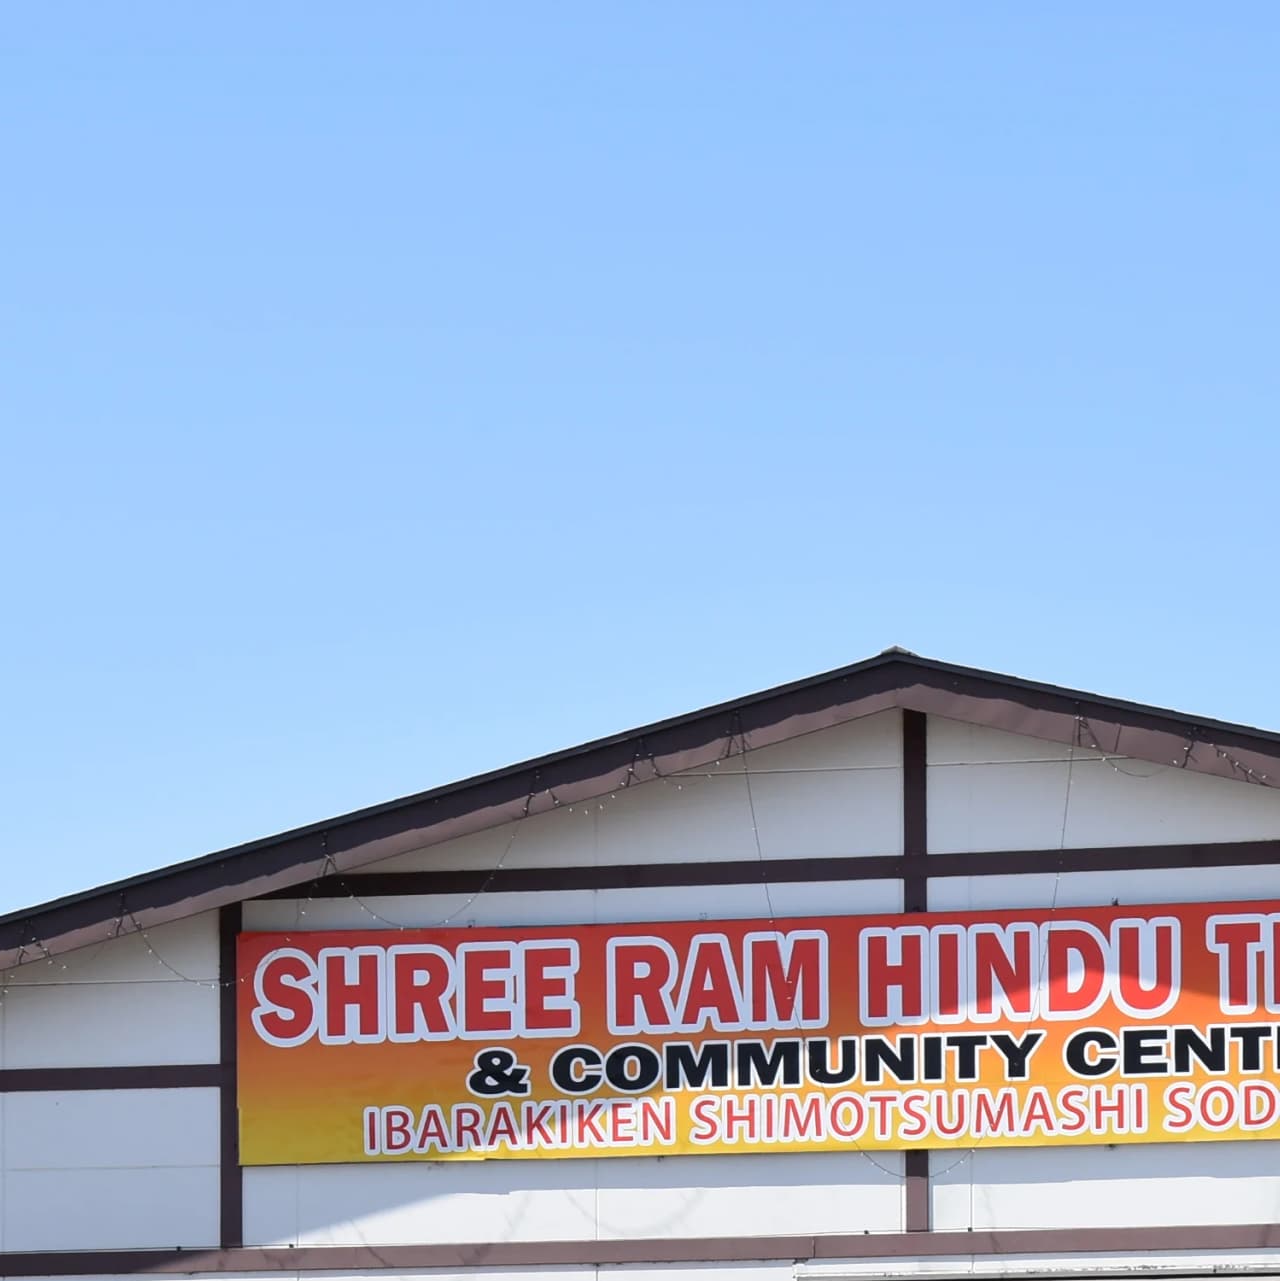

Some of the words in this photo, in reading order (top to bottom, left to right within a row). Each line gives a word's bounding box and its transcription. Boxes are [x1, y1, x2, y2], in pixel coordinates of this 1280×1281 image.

[255, 942, 578, 1044] SHREE
[610, 933, 825, 1033] RAM
[863, 920, 1177, 1022] HINDU
[468, 1049, 529, 1096] &
[551, 1030, 1044, 1092] COMMUNITY
[367, 1099, 674, 1152] IBARAKIKEN
[692, 1087, 1145, 1141] SHIMOTSUMASHI
